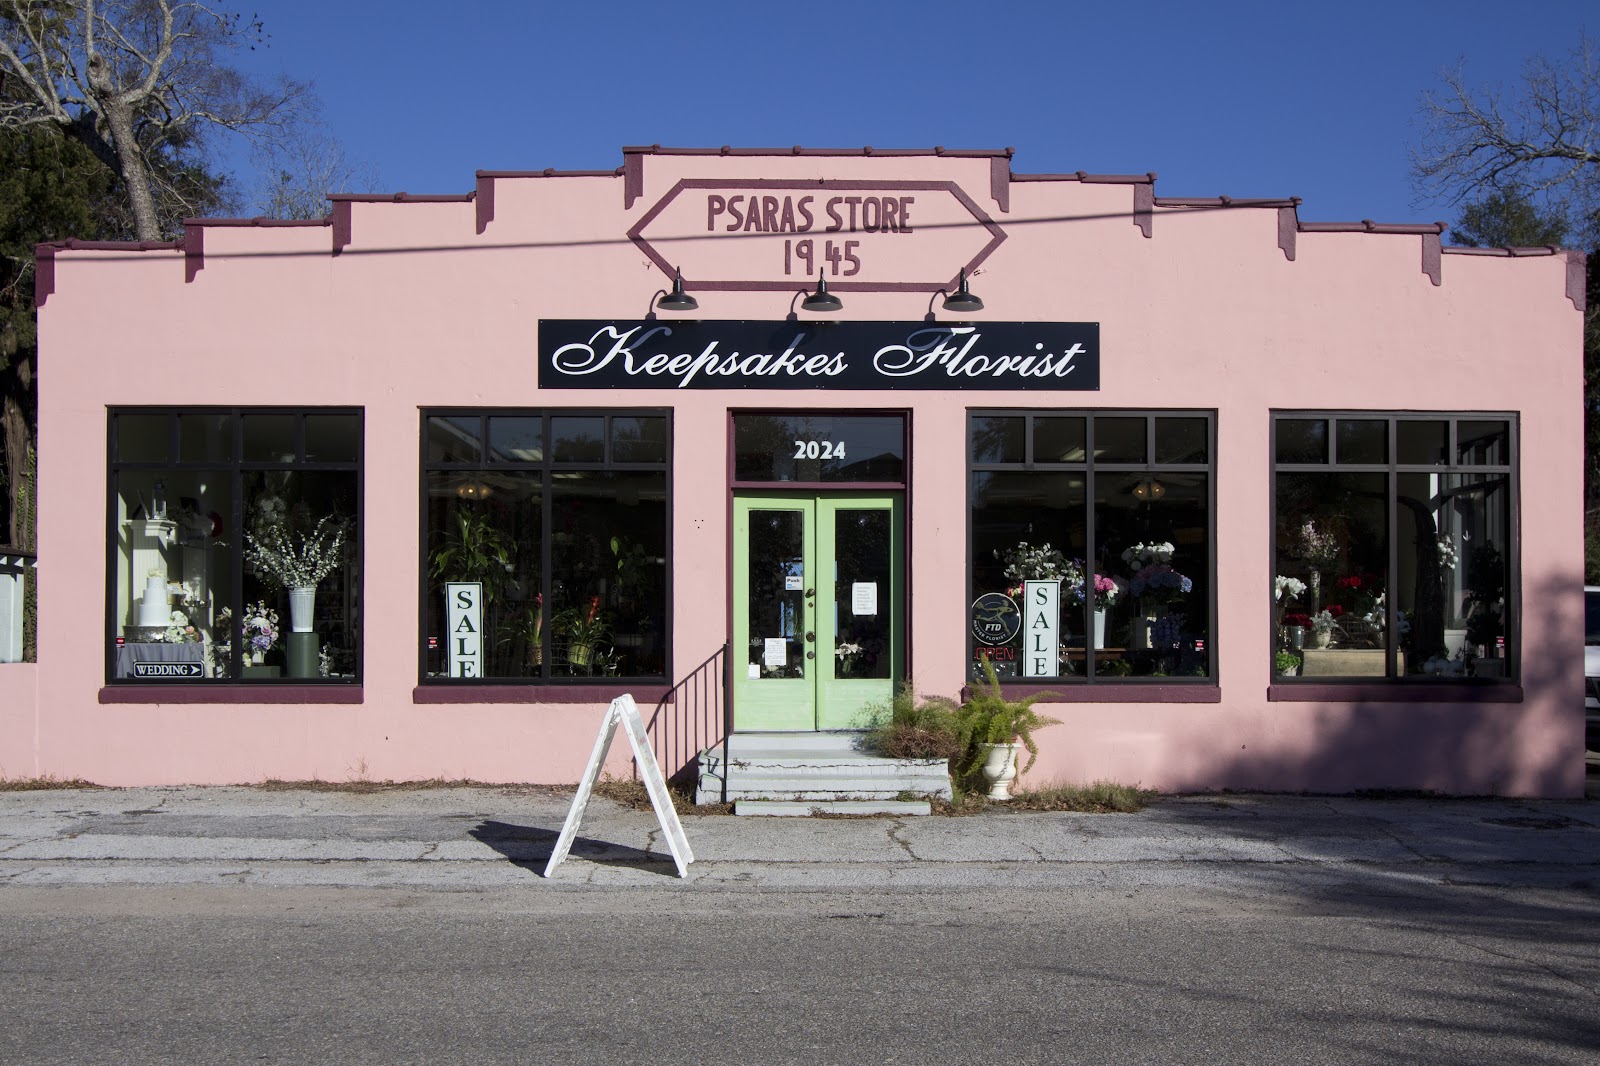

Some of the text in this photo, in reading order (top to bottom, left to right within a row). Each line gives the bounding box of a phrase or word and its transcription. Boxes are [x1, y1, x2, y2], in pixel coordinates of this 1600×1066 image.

[707, 194, 915, 234] PSARAS STORE
[784, 238, 861, 276] 1945
[551, 325, 1087, 388] Keepsakes Florist
[793, 440, 846, 460] 2024
[454, 590, 477, 678] SALE
[985, 623, 1002, 632] FTD
[986, 633, 1007, 641] FLORIST
[1032, 586, 1050, 676] SALE
[975, 647, 1015, 660] OPEN
[136, 664, 188, 676] WEDDING
